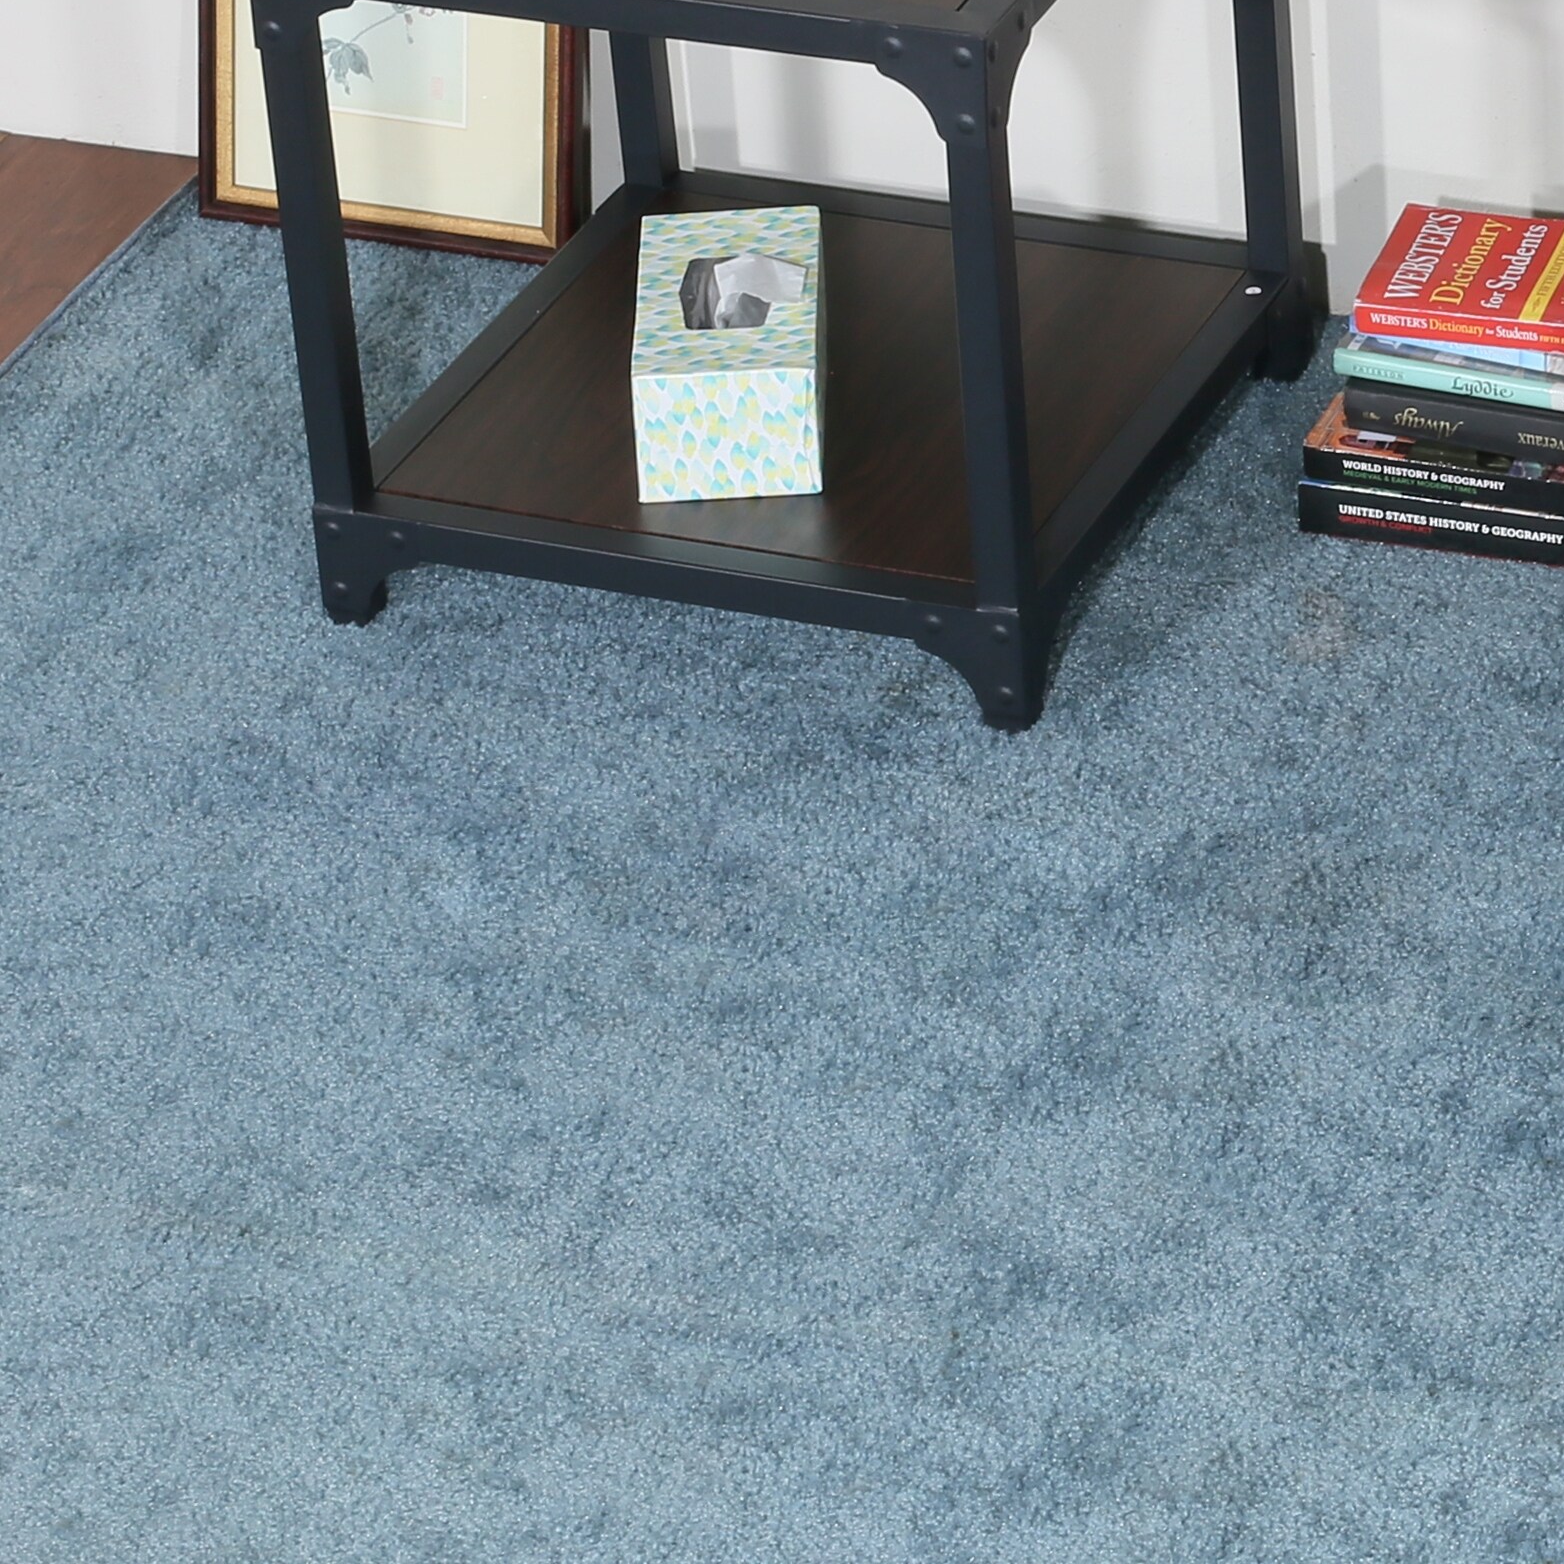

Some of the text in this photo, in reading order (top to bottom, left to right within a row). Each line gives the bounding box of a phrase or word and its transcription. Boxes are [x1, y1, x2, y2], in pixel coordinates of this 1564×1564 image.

[1384, 212, 1463, 298] WEBSTER'S
[1429, 218, 1512, 306] Dictionary
[1481, 224, 1549, 309] for Students
[1370, 312, 1428, 329] WEBSTER'S
[1429, 318, 1485, 337] Dictionary
[1496, 325, 1539, 342] Students
[1539, 334, 1560, 343] FIFTH
[1451, 376, 1514, 399] Lyddie
[1393, 407, 1464, 436] Always
[1342, 459, 1382, 474] WORLD
[1382, 465, 1429, 480] HISTORY
[1439, 472, 1505, 491] GEOGRAPHY
[1338, 504, 1384, 519] UNITED
[1385, 511, 1427, 526] STATES
[1428, 517, 1480, 534] HISTORY
[1491, 525, 1564, 545] GEOGRAPHY
